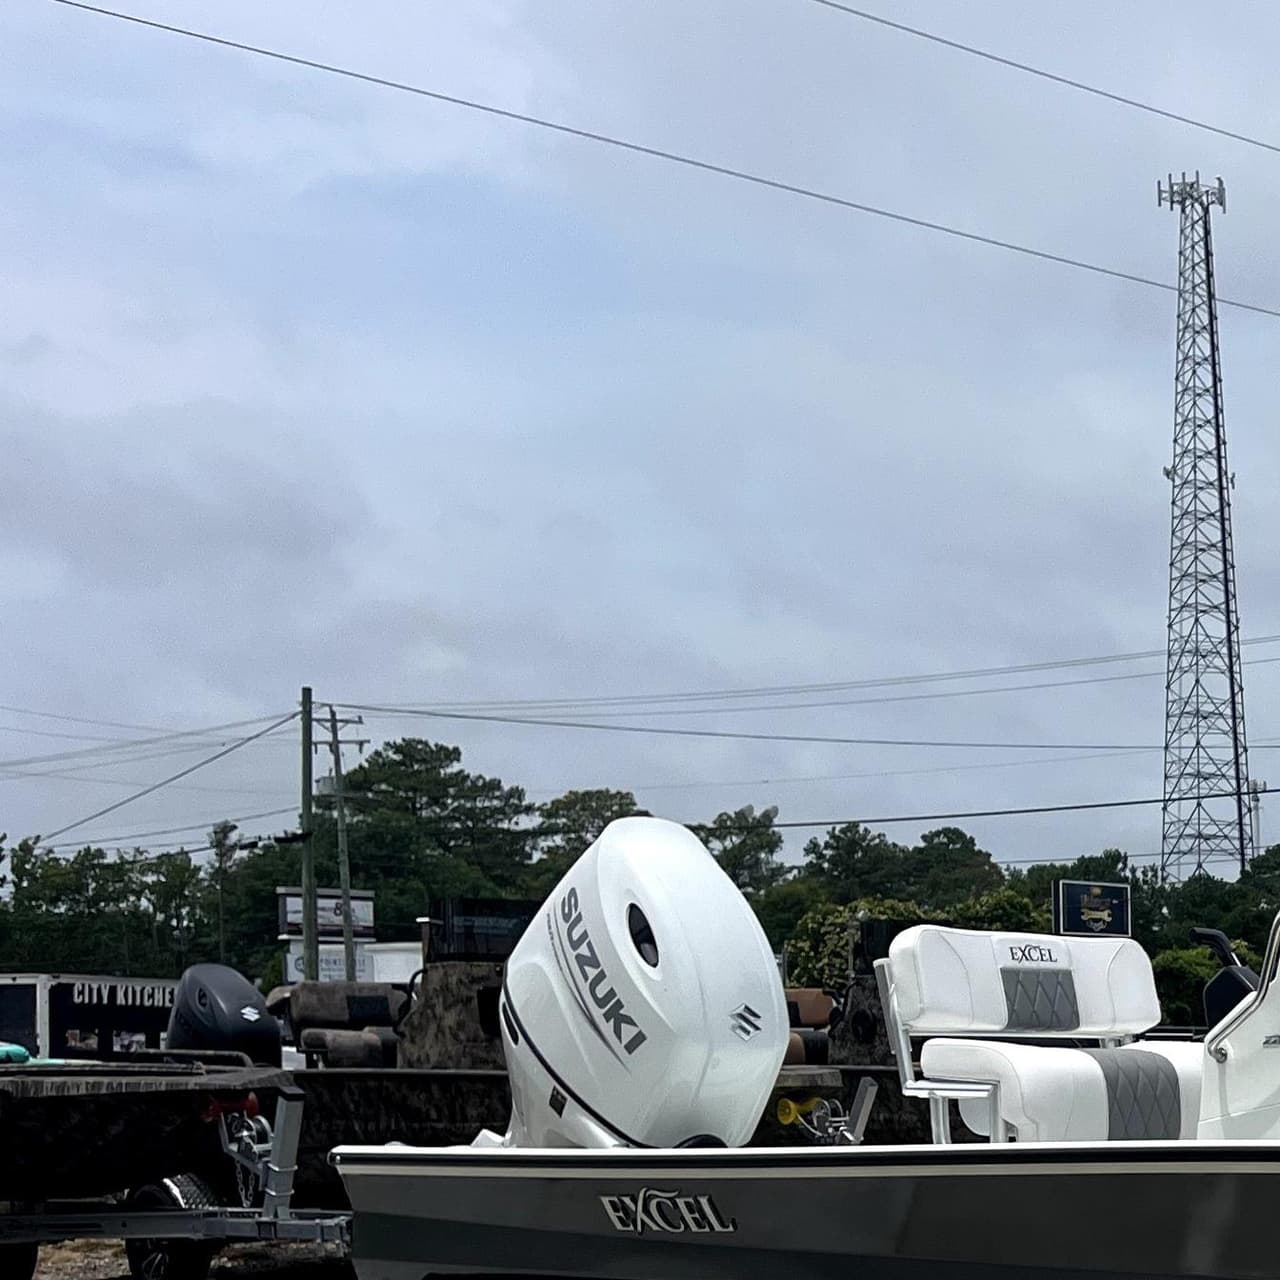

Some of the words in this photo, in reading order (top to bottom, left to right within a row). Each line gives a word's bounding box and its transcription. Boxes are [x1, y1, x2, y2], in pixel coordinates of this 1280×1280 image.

[561, 887, 648, 1055] SUZUKI
[1009, 944, 1058, 963] EXCEL
[73, 983, 109, 1005] CITY
[116, 984, 178, 1007] KITCHE
[599, 1187, 737, 1233] EXCEL
